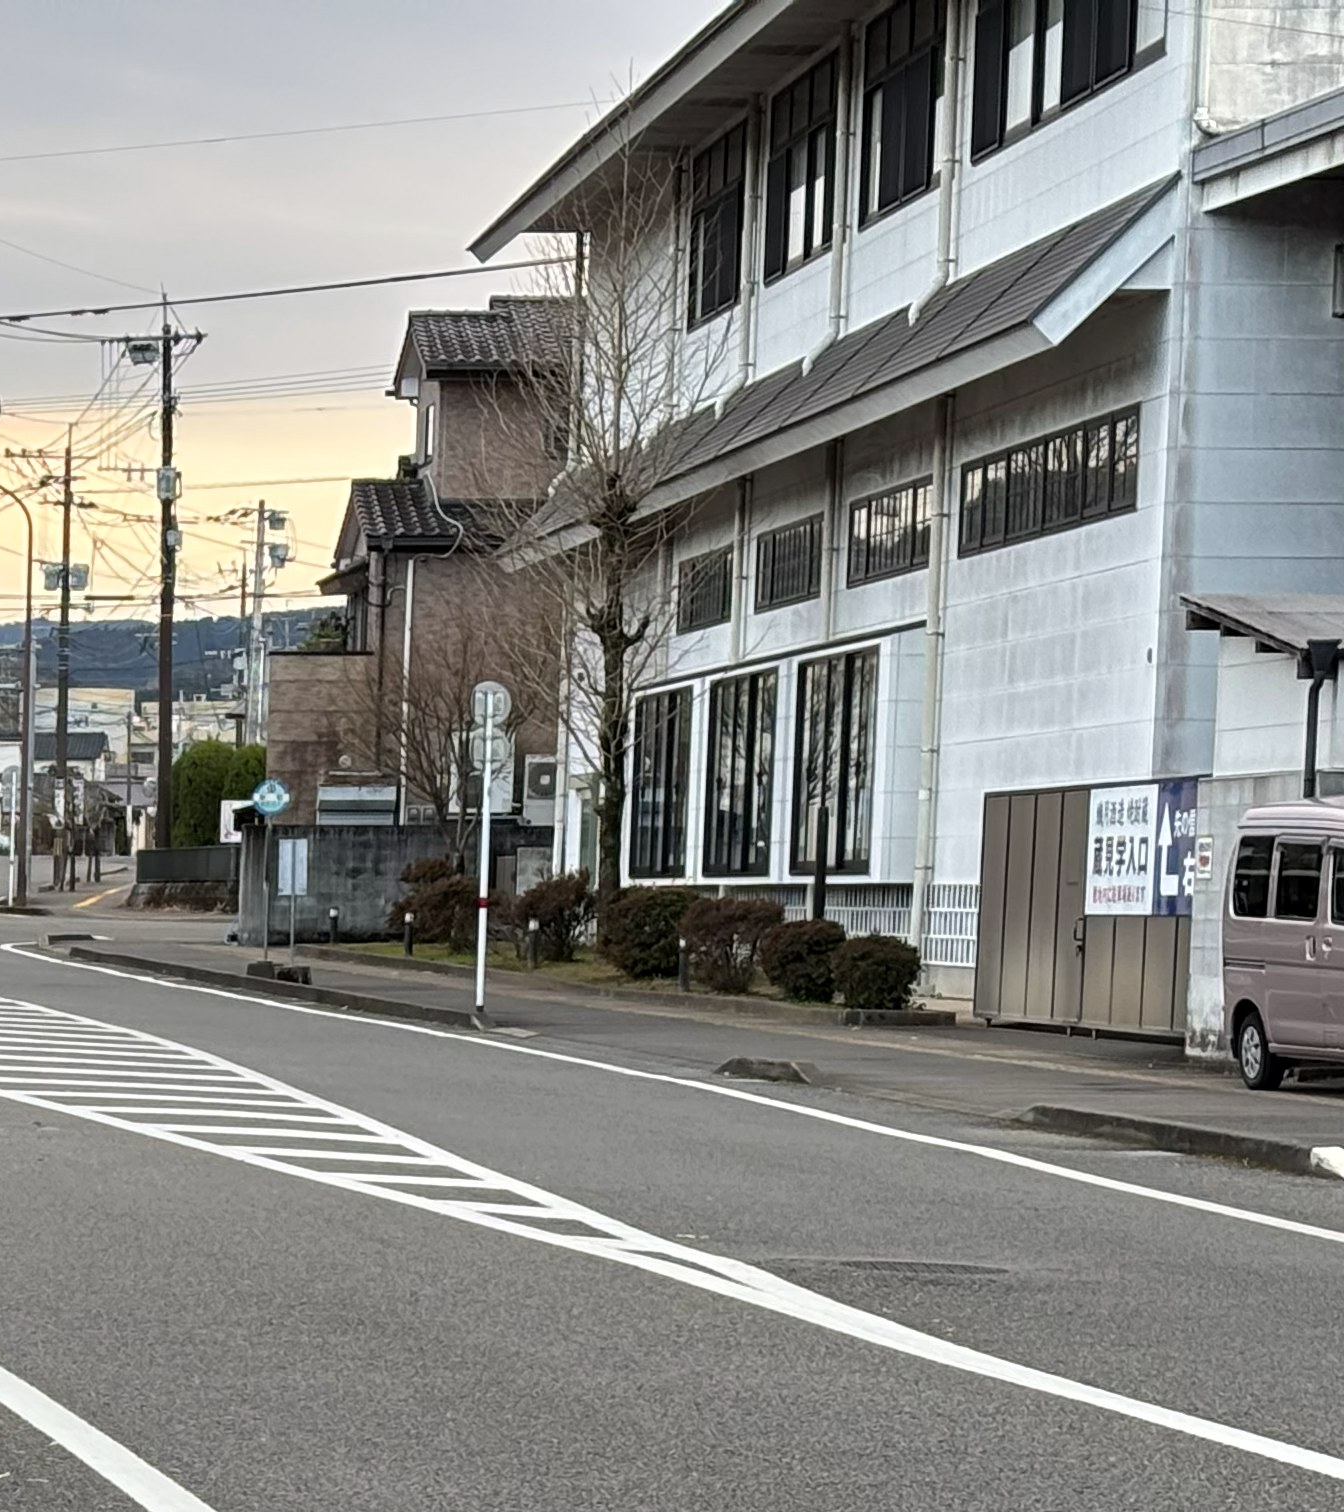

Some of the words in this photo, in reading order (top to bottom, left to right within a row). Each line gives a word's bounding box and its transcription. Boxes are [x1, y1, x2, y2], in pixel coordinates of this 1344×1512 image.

[1092, 836, 1149, 877] 蔵見学入口
